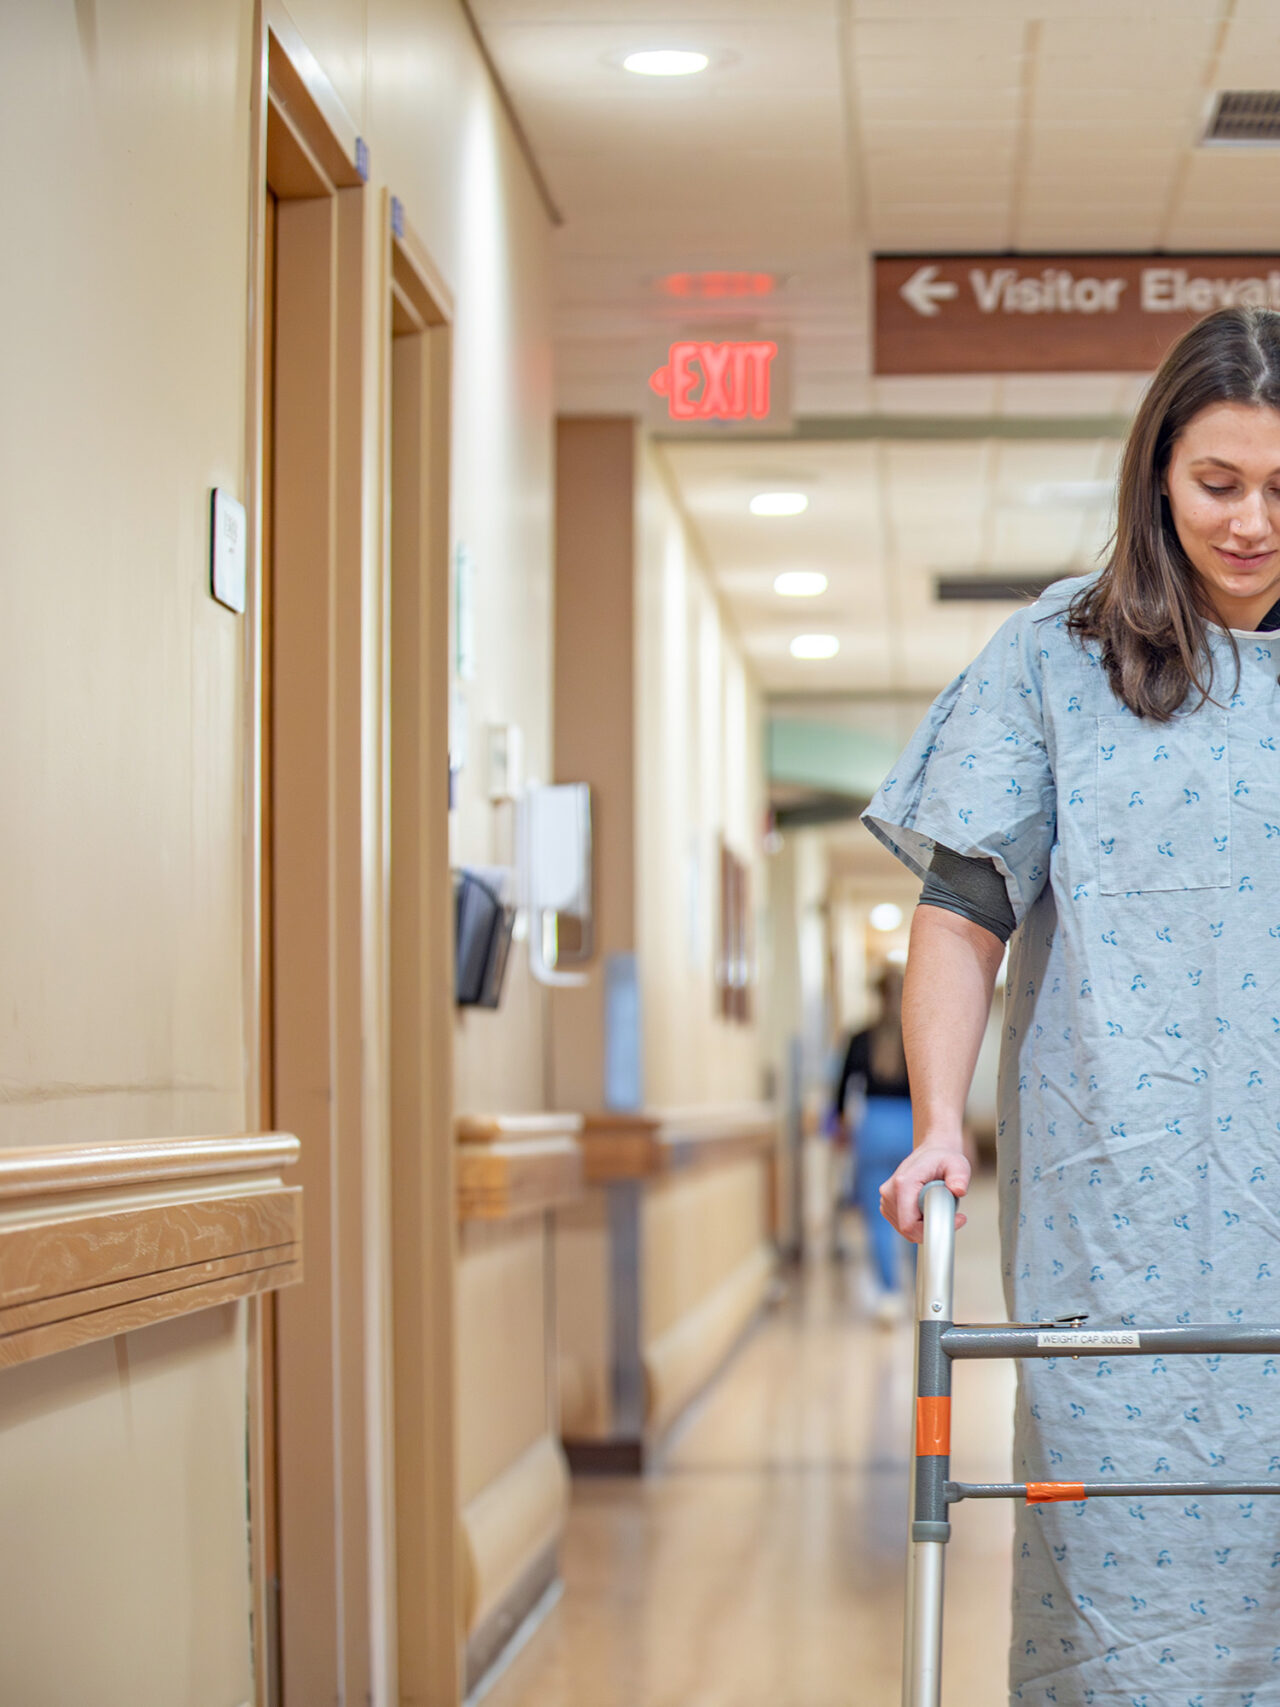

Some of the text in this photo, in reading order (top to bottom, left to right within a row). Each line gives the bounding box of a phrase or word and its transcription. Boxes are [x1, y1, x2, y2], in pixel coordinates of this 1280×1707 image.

[969, 268, 1127, 313] Visitor
[669, 341, 778, 420] EXIT
[1042, 1335, 1133, 1345] WEIGHT CAP 300LBS
